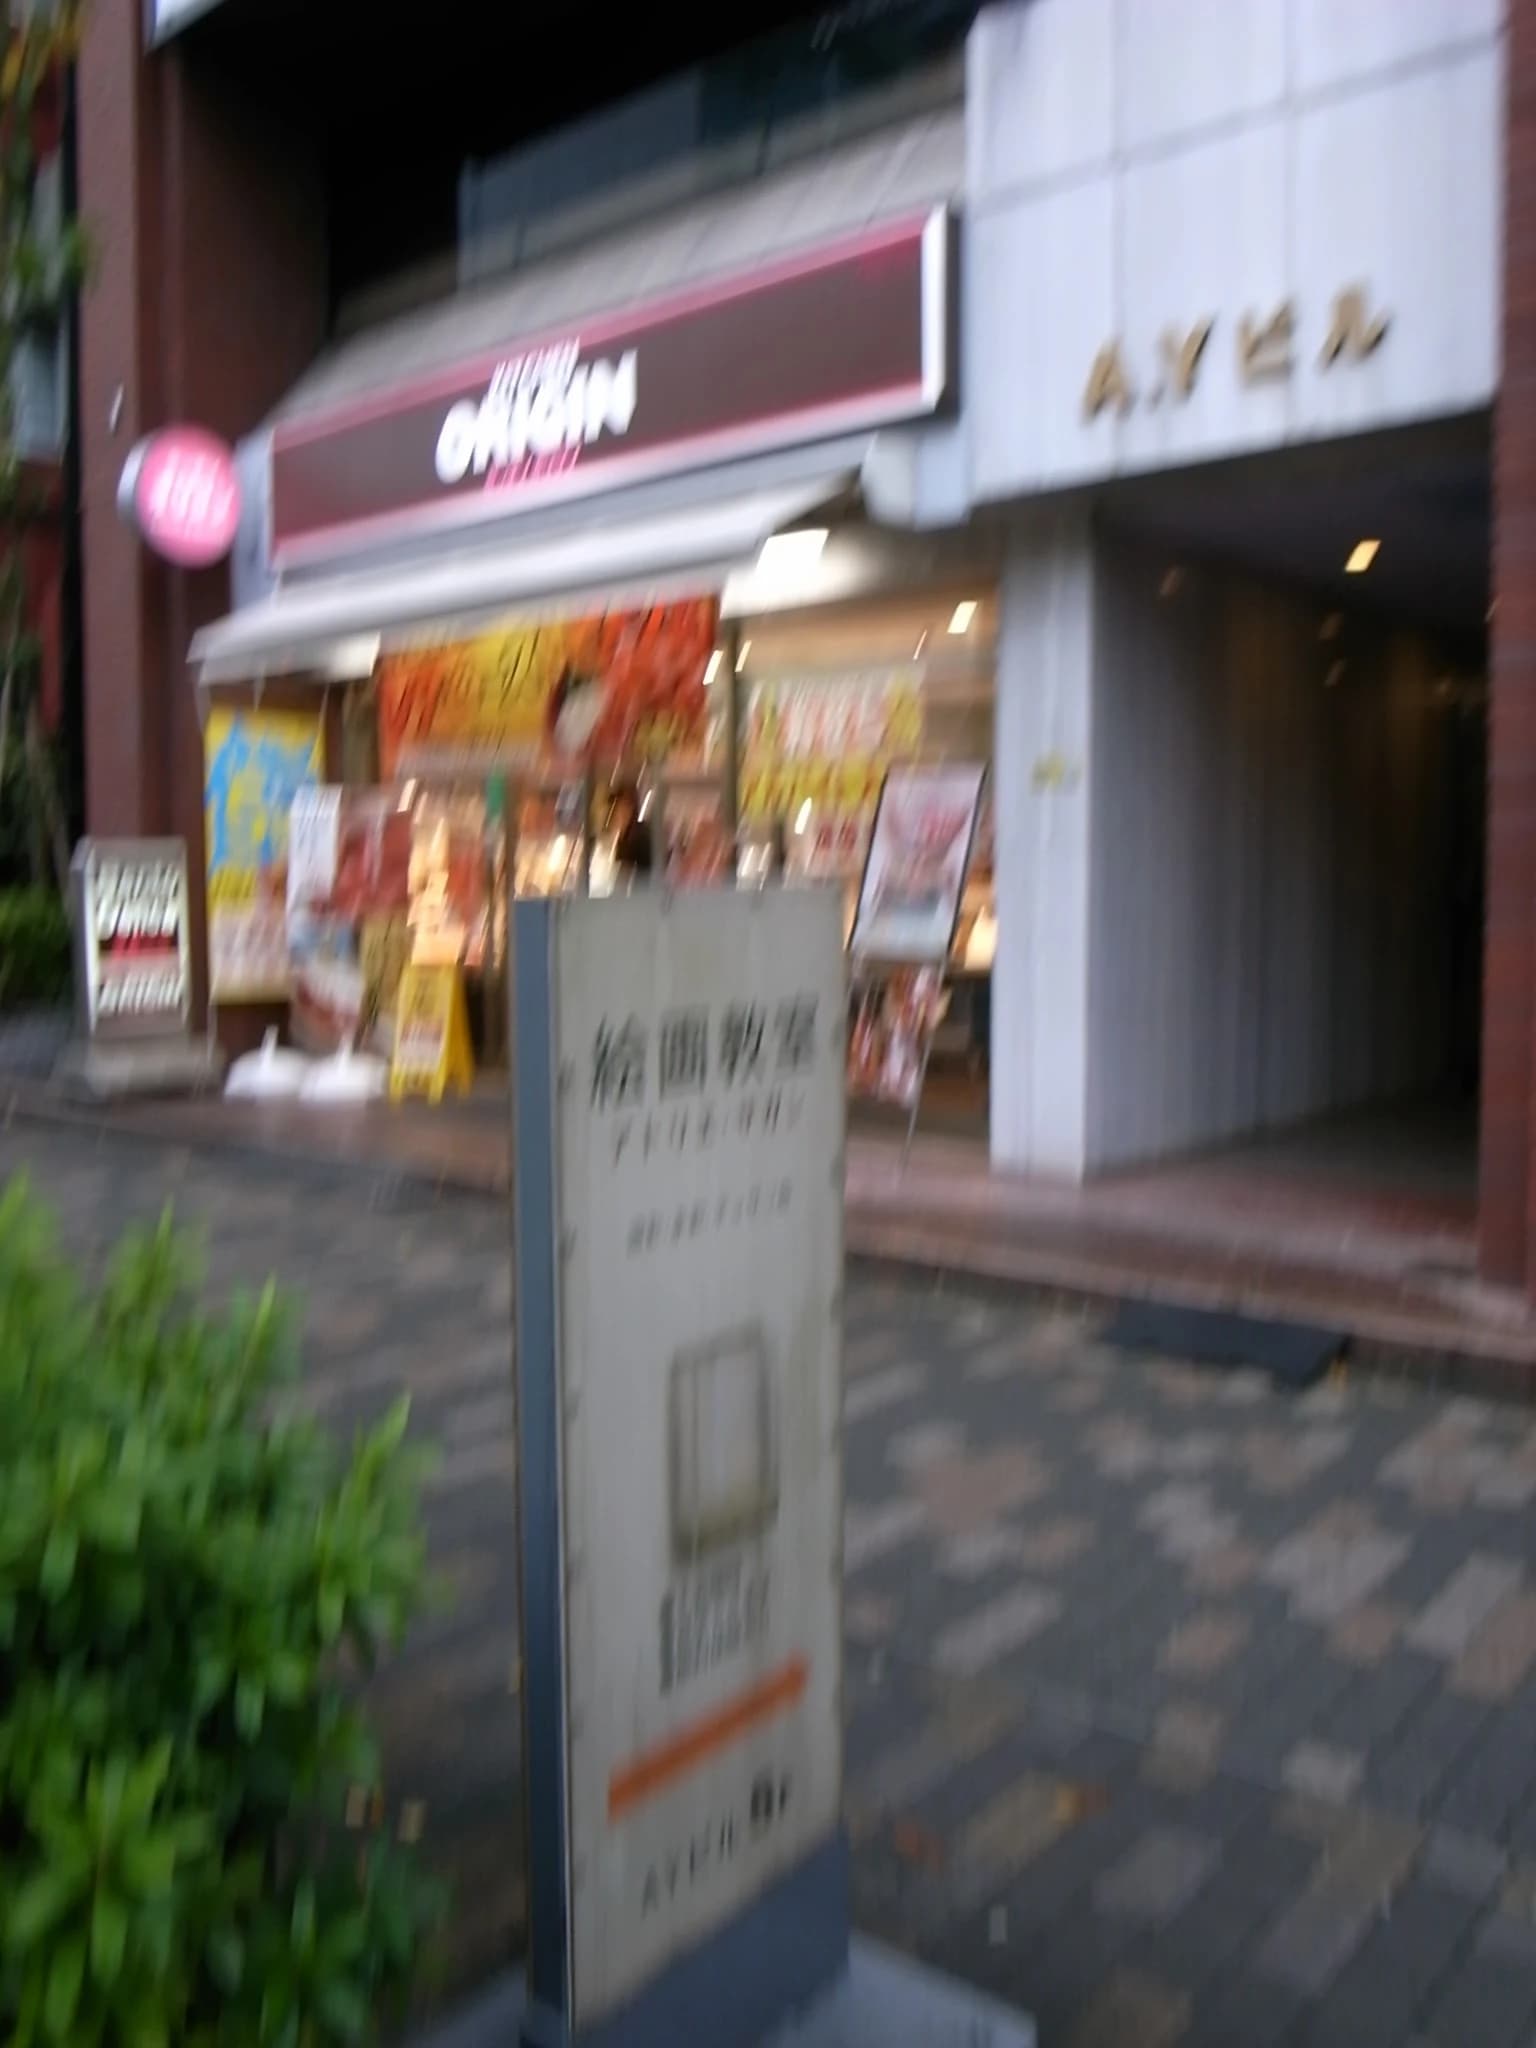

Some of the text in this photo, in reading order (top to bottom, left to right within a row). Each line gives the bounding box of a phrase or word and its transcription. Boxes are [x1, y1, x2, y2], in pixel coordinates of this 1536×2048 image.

[436, 350, 637, 485] ORIGIN
[591, 996, 818, 1108] 絵画教室
